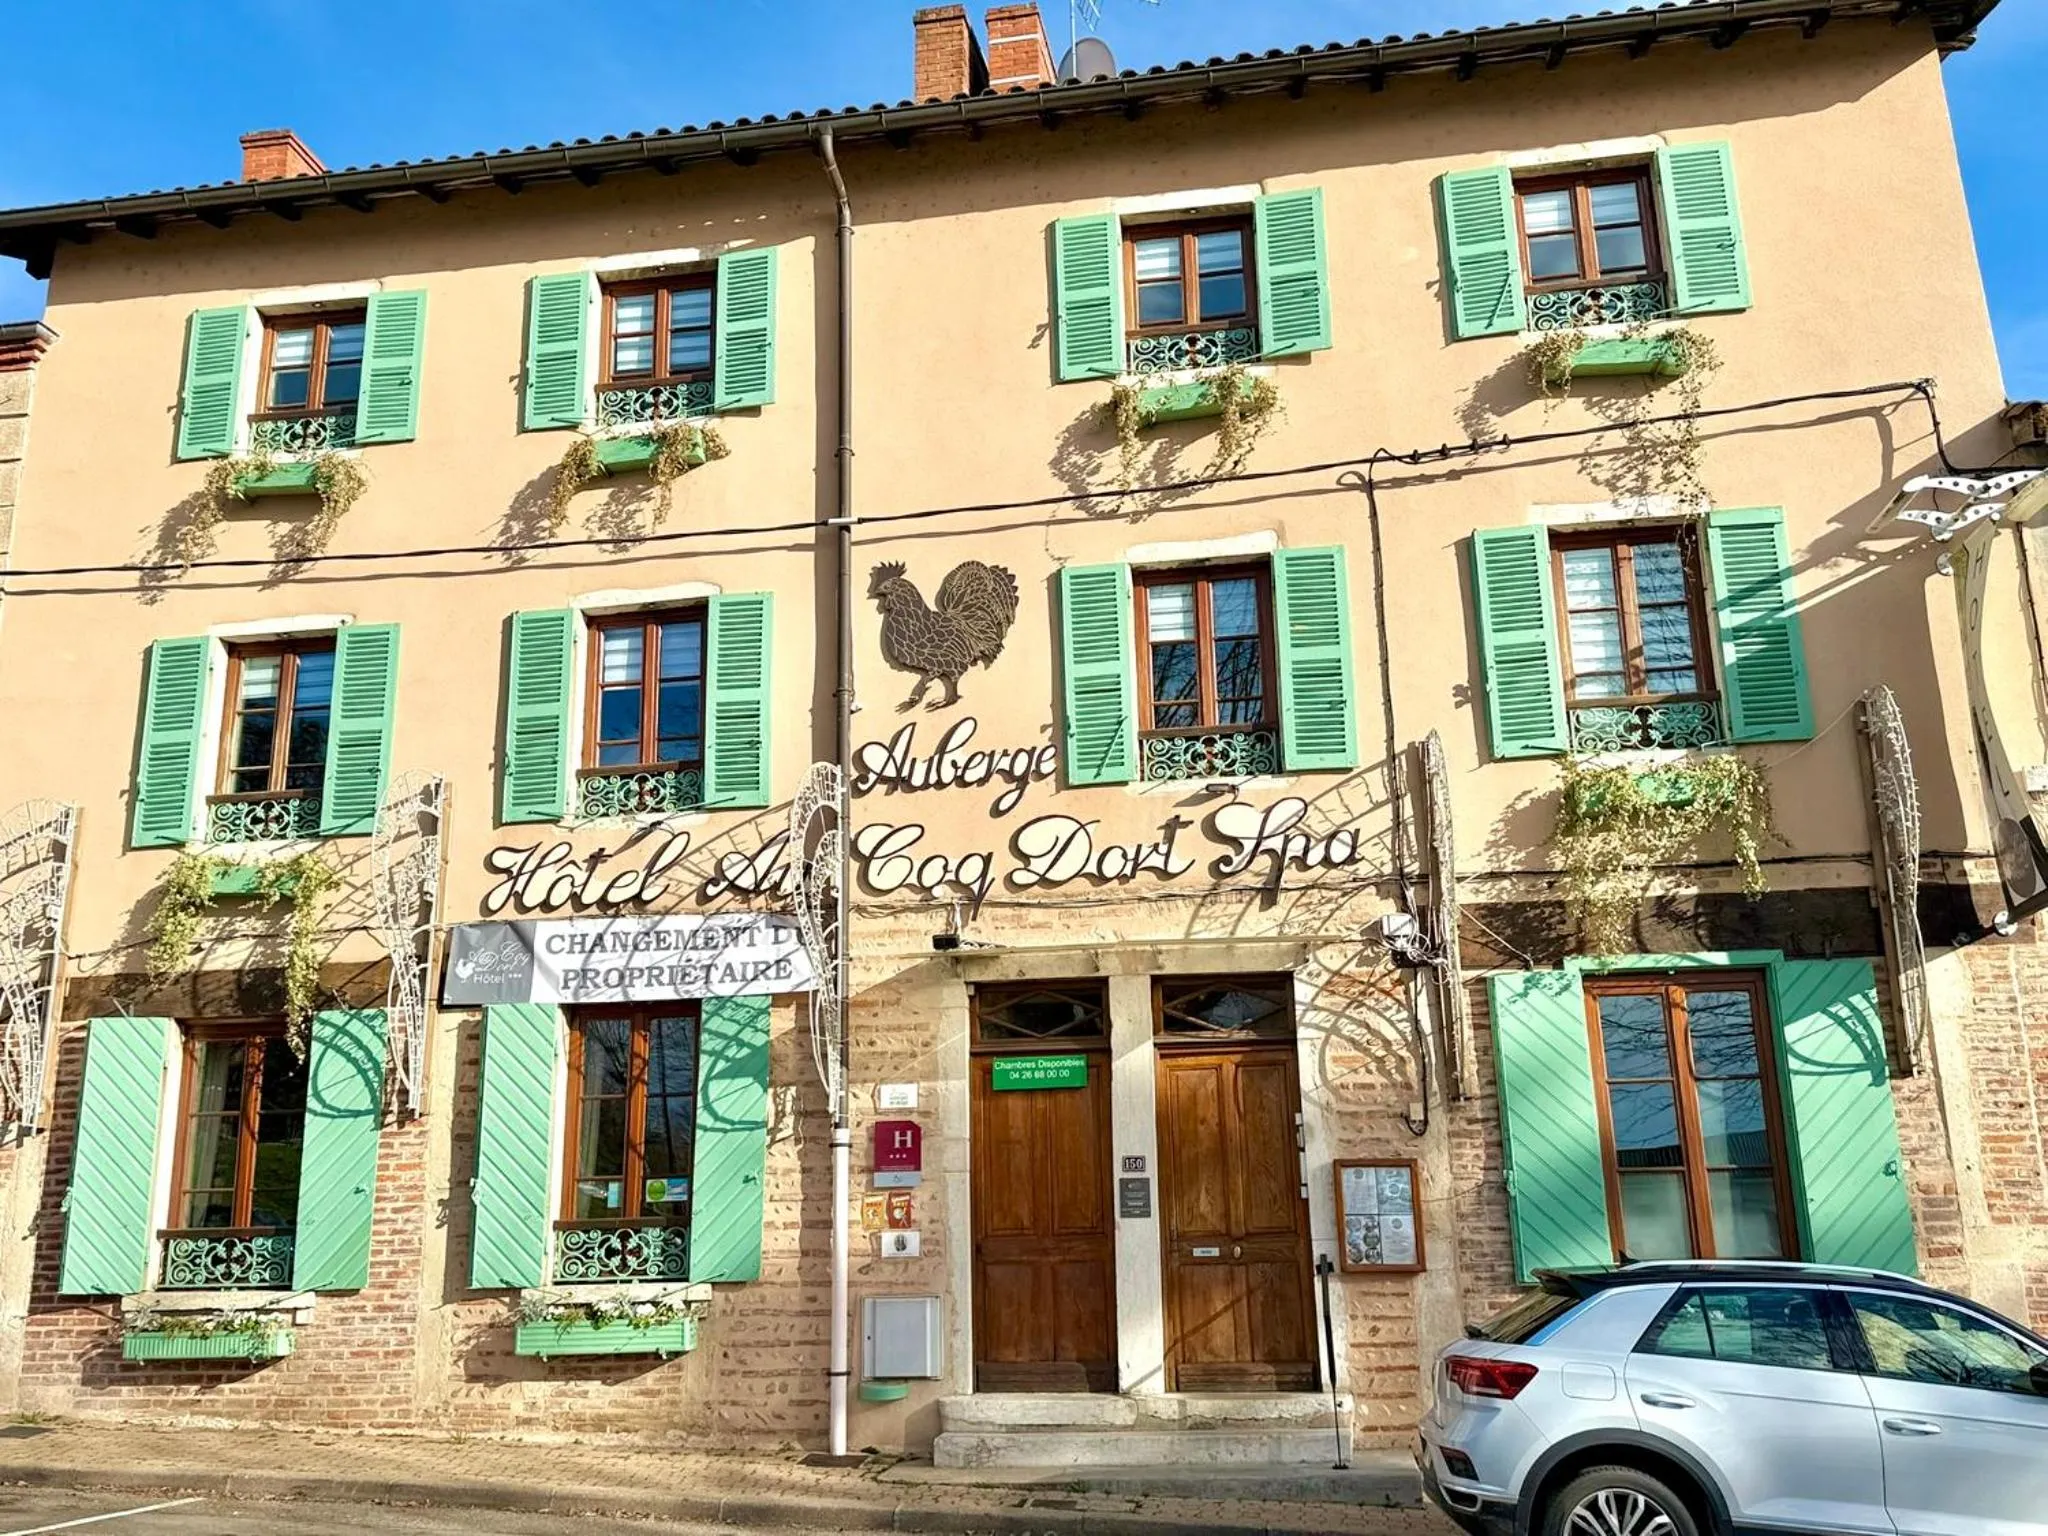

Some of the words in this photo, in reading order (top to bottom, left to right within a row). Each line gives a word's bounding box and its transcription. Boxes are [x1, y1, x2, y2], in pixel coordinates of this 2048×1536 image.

[853, 717, 1057, 814] Auberge
[483, 831, 691, 914] Hôtel
[852, 822, 996, 921] Coq
[1006, 814, 1196, 890] Dort
[1204, 797, 1365, 908] Spa
[545, 924, 762, 955] CHANGEMENT
[995, 1060, 1036, 1070] Chambres
[1038, 1058, 1084, 1068] Disponibles
[1009, 1071, 1020, 1080] 04
[1046, 1069, 1057, 1078] 00
[1059, 1069, 1070, 1077] 00
[894, 1130, 912, 1149] H
[1125, 1158, 1143, 1169] 150
